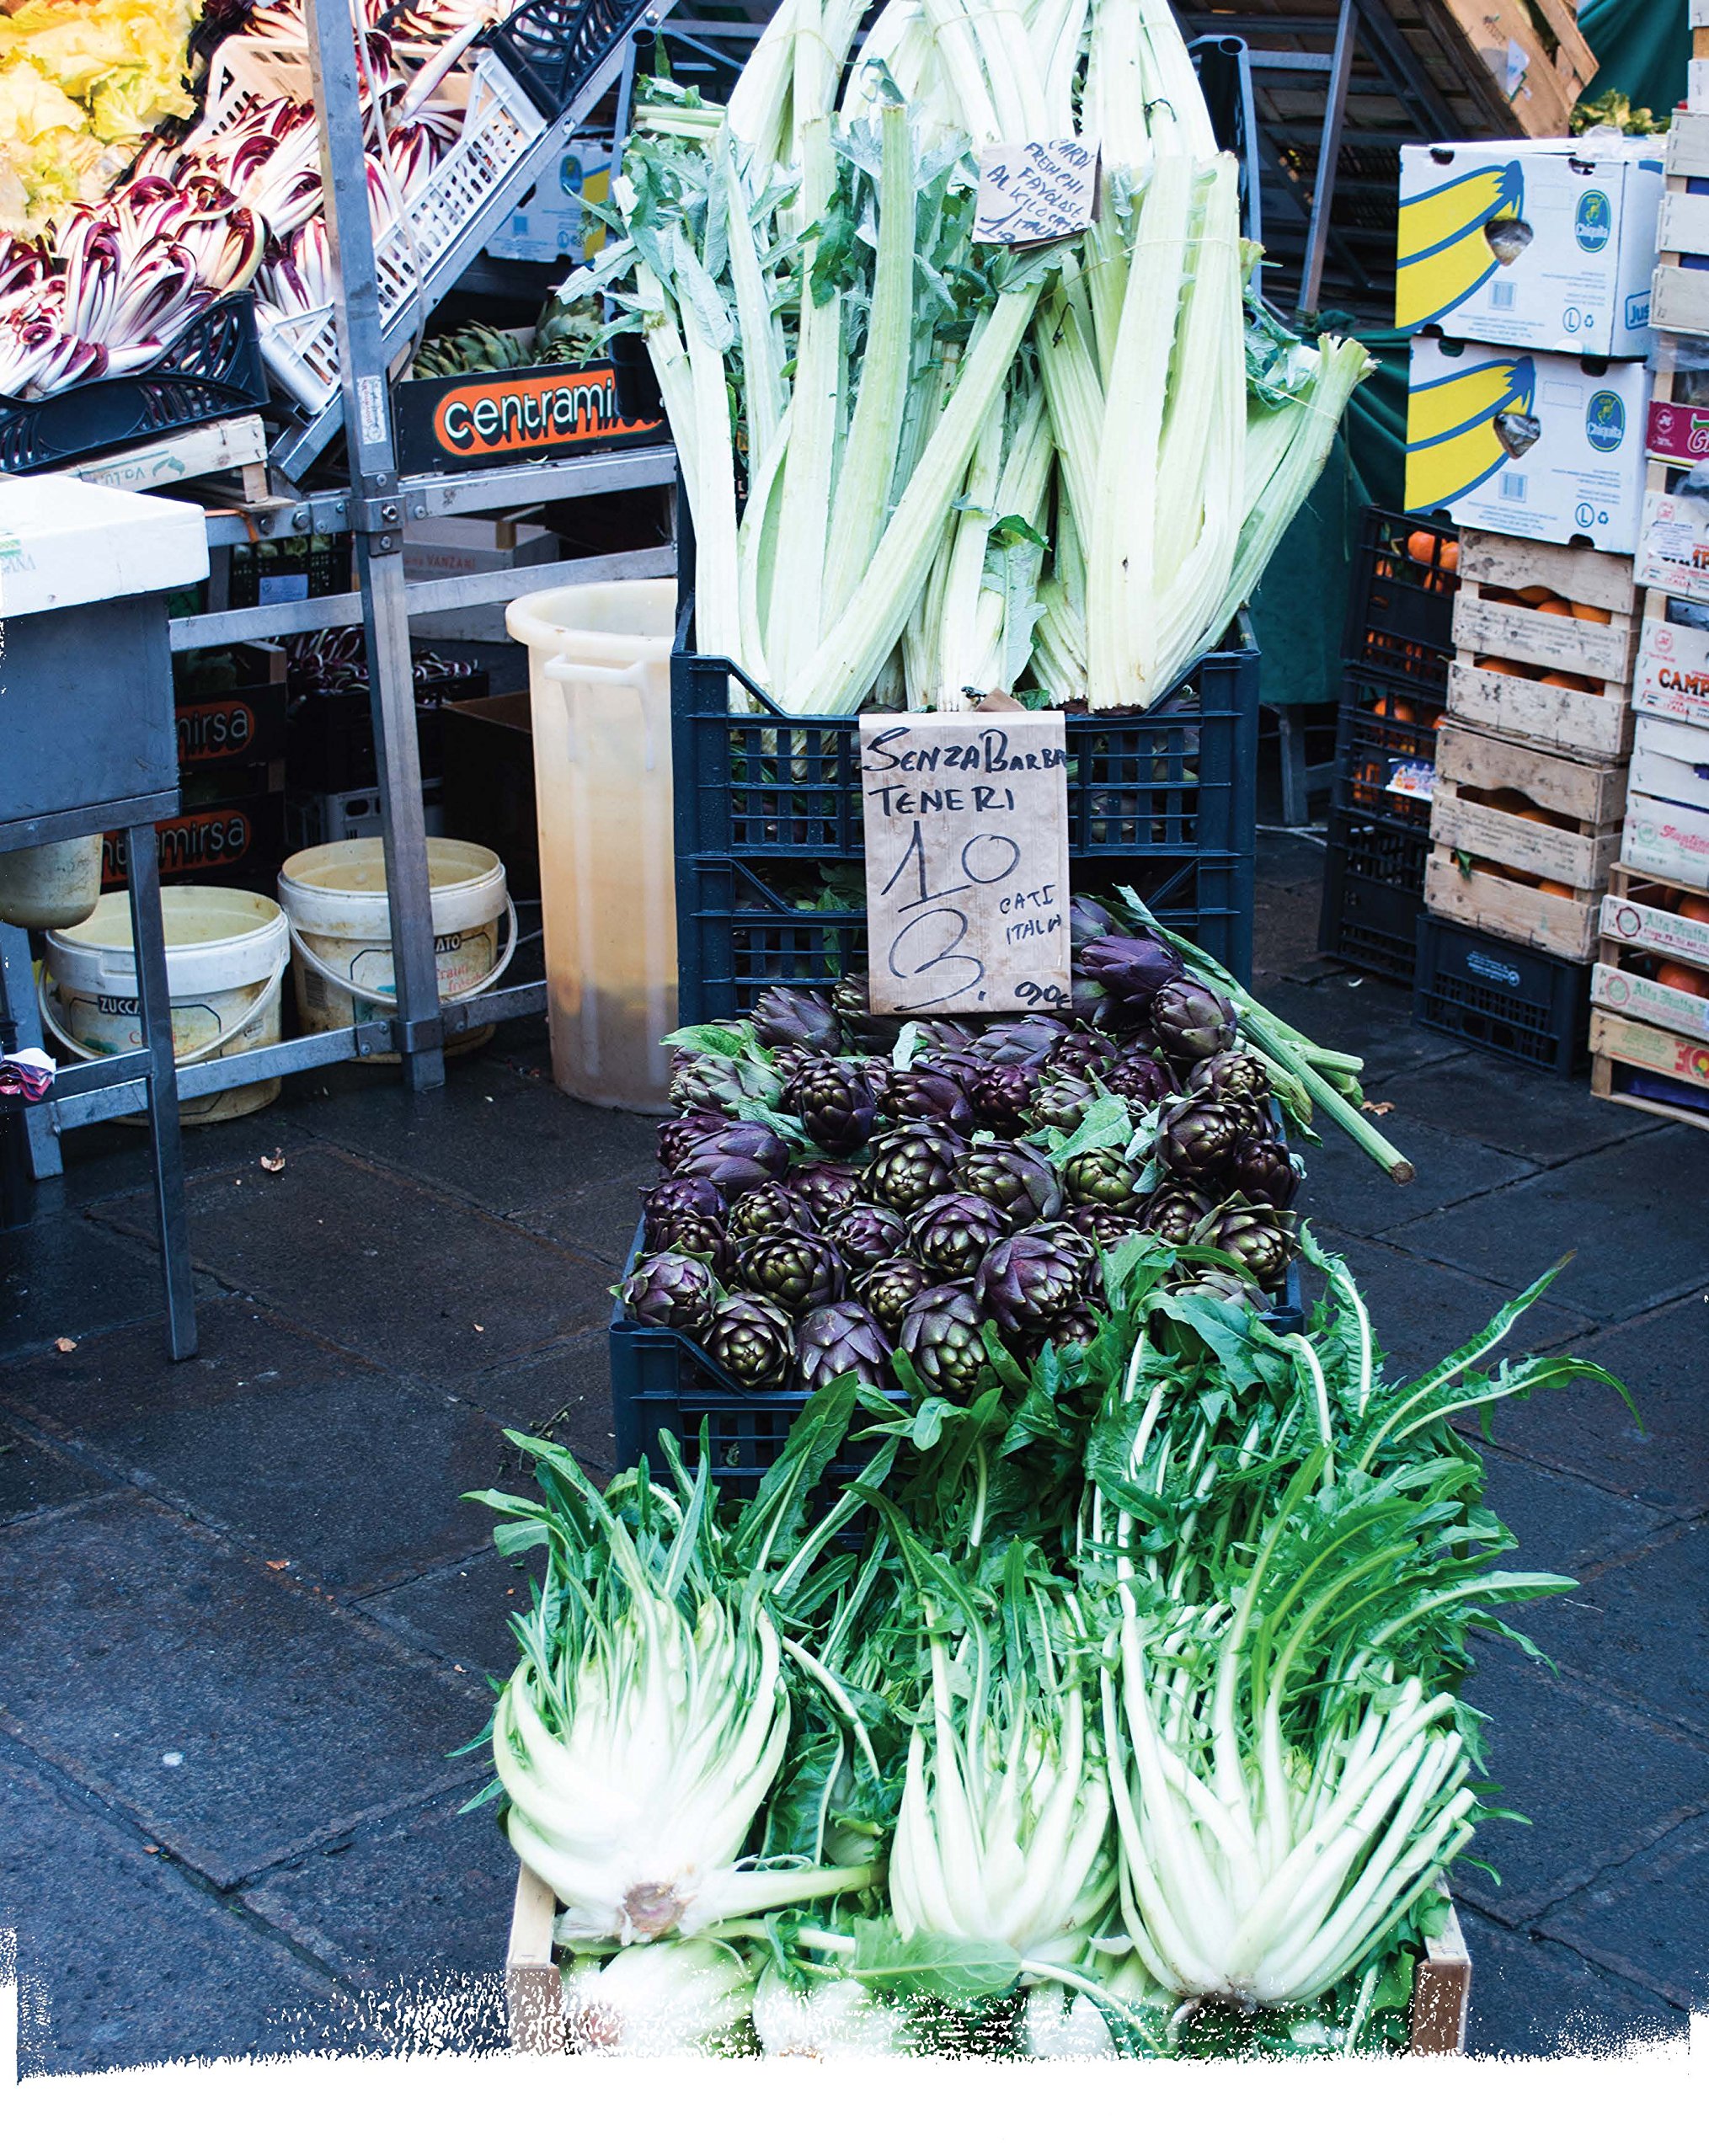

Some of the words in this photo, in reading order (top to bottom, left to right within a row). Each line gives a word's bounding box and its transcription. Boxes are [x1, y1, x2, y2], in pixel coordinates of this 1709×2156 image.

[986, 164, 1010, 191] AL
[1009, 186, 1047, 217] KILO
[863, 726, 981, 772] SENZA
[868, 784, 1015, 817] TENERI
